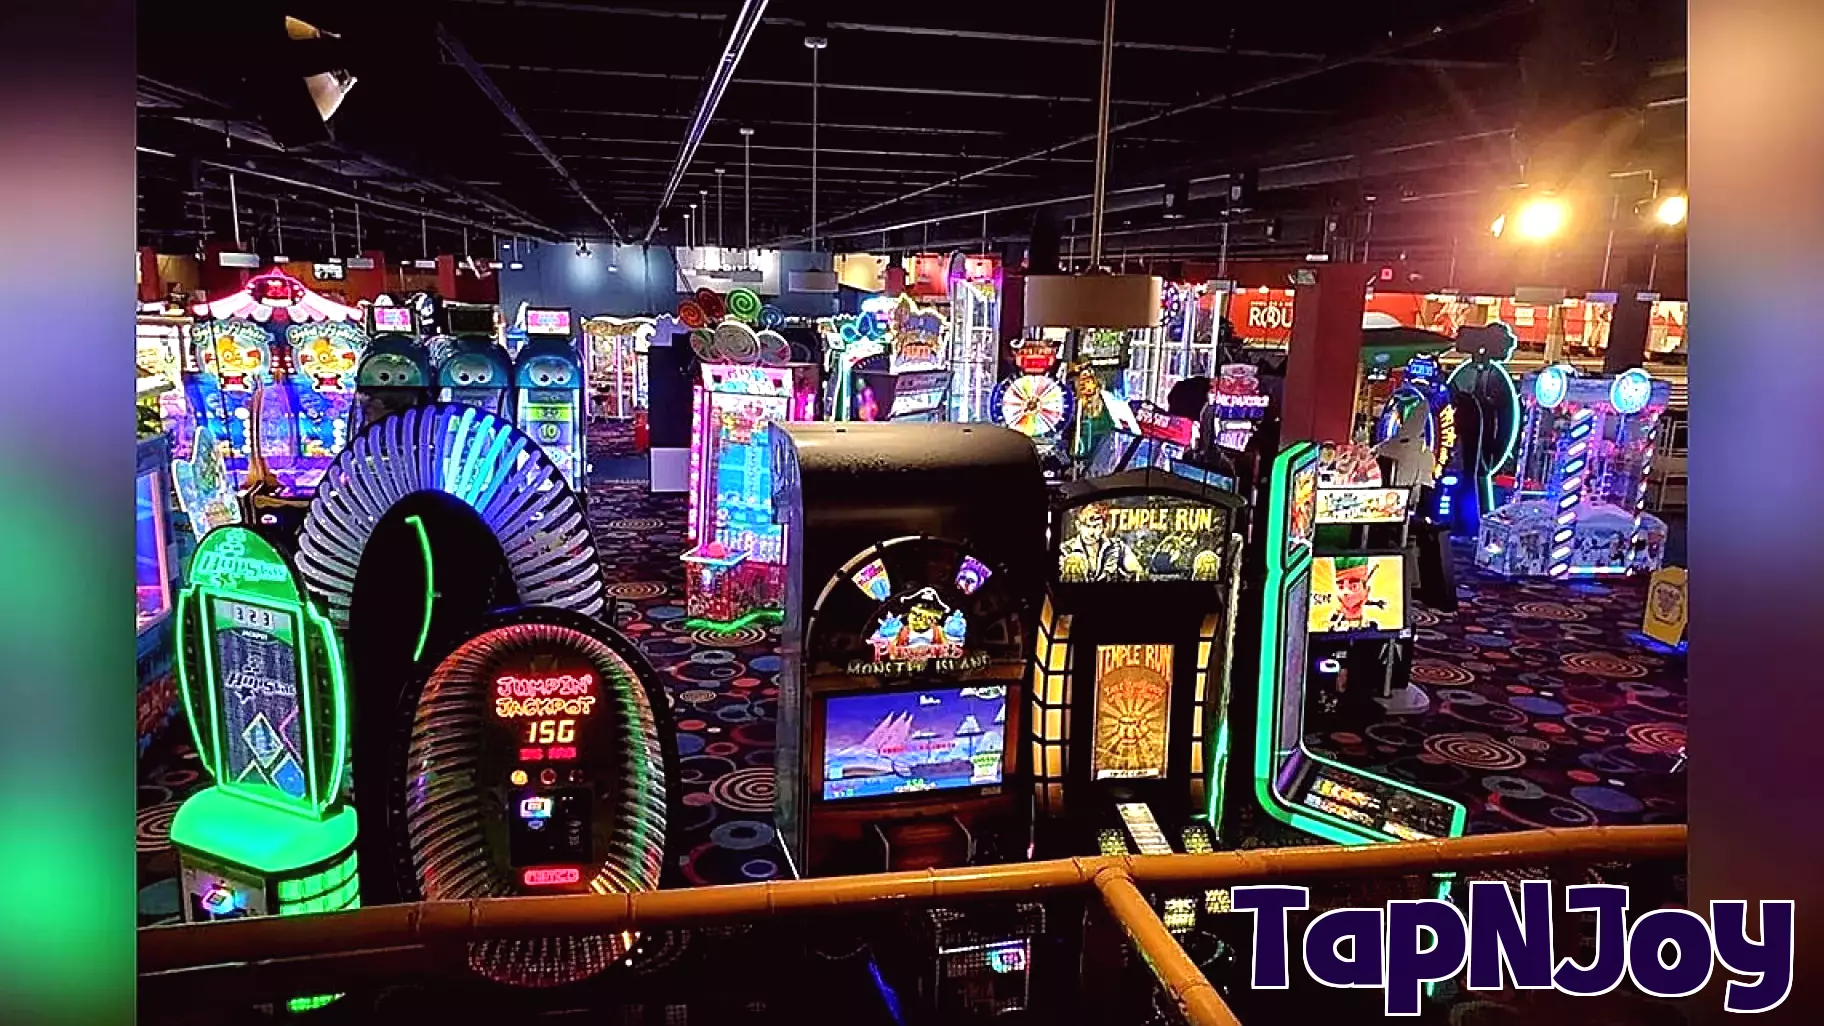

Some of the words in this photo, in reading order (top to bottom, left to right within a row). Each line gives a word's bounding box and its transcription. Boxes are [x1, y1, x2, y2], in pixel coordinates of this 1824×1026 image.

[1108, 507, 1169, 532] TEMPLE
[1175, 507, 1213, 533] RUN
[1097, 644, 1142, 681] TEMPLE
[1144, 644, 1173, 681] RUN
[495, 695, 596, 718] JACKPOT
